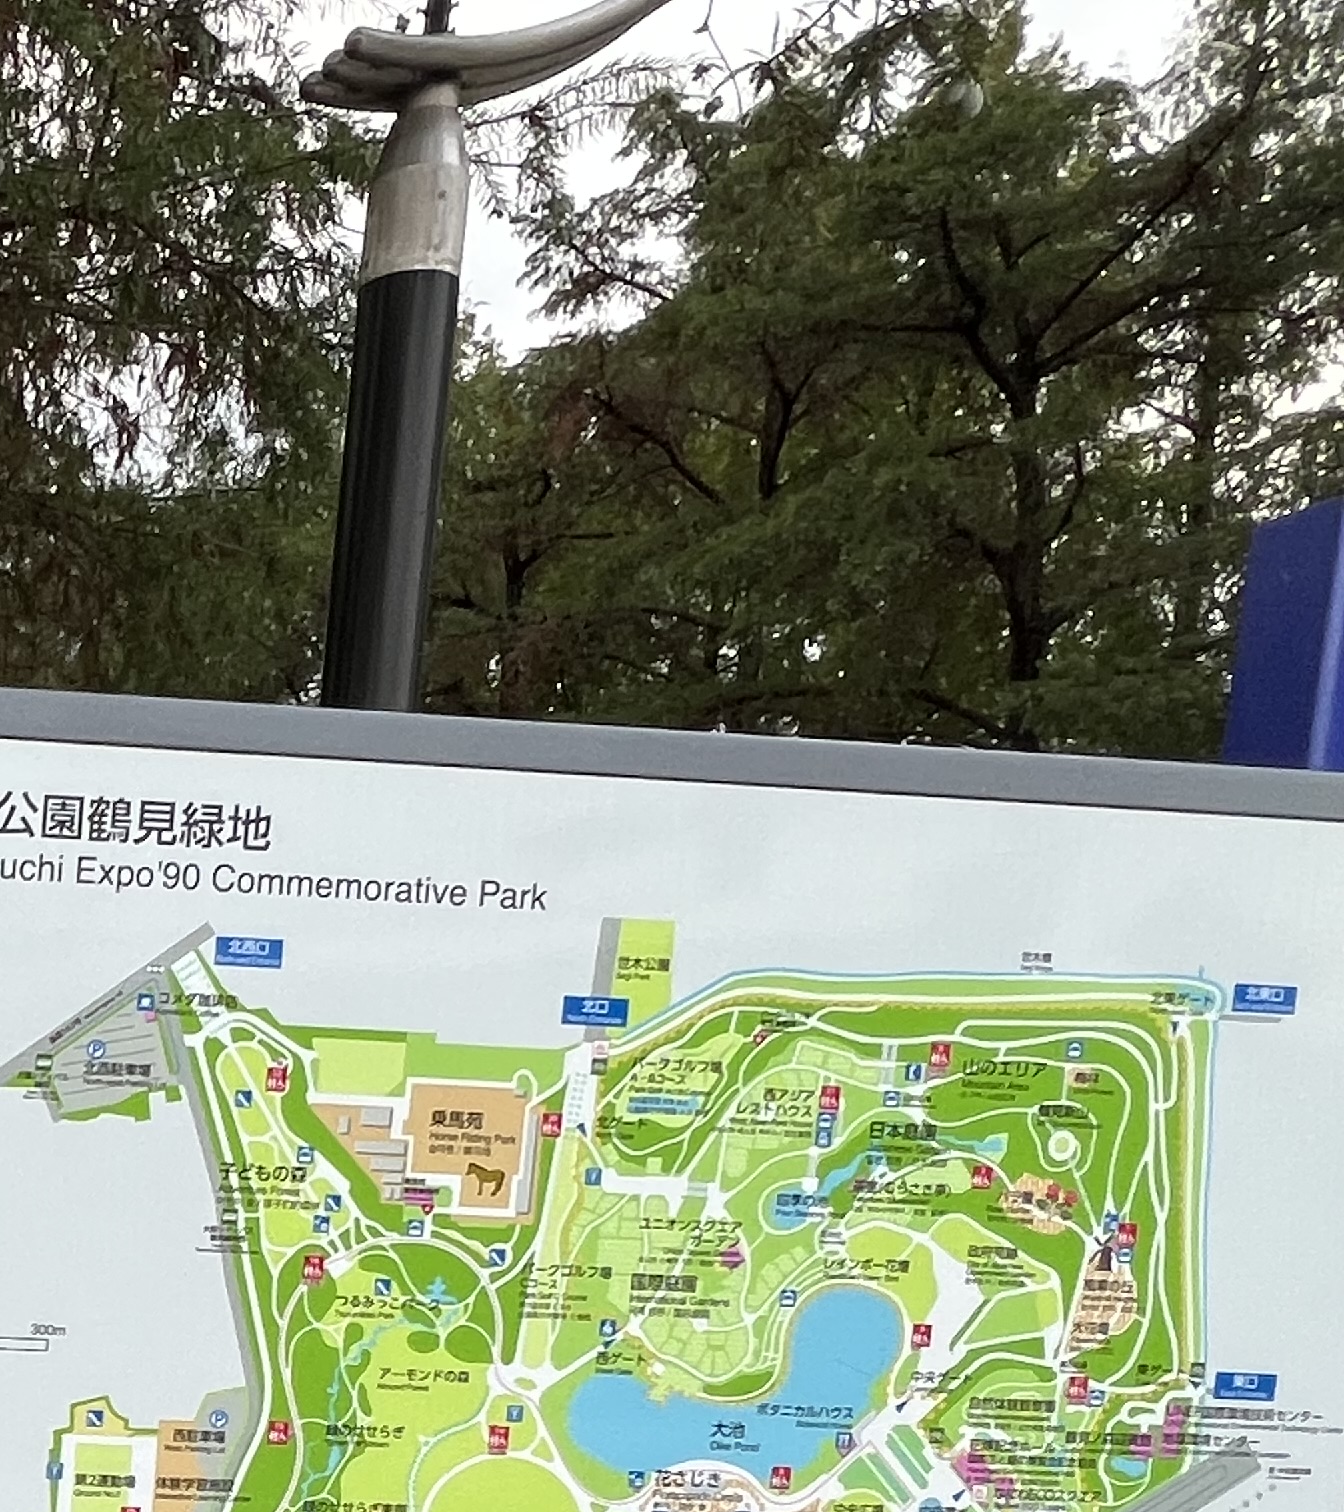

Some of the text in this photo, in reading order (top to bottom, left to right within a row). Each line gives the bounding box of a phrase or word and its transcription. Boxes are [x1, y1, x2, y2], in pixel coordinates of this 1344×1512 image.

[75, 857, 203, 894] Expo'90
[211, 864, 468, 909] Commemorative
[477, 880, 548, 914] Park
[709, 1420, 747, 1440] 大池
